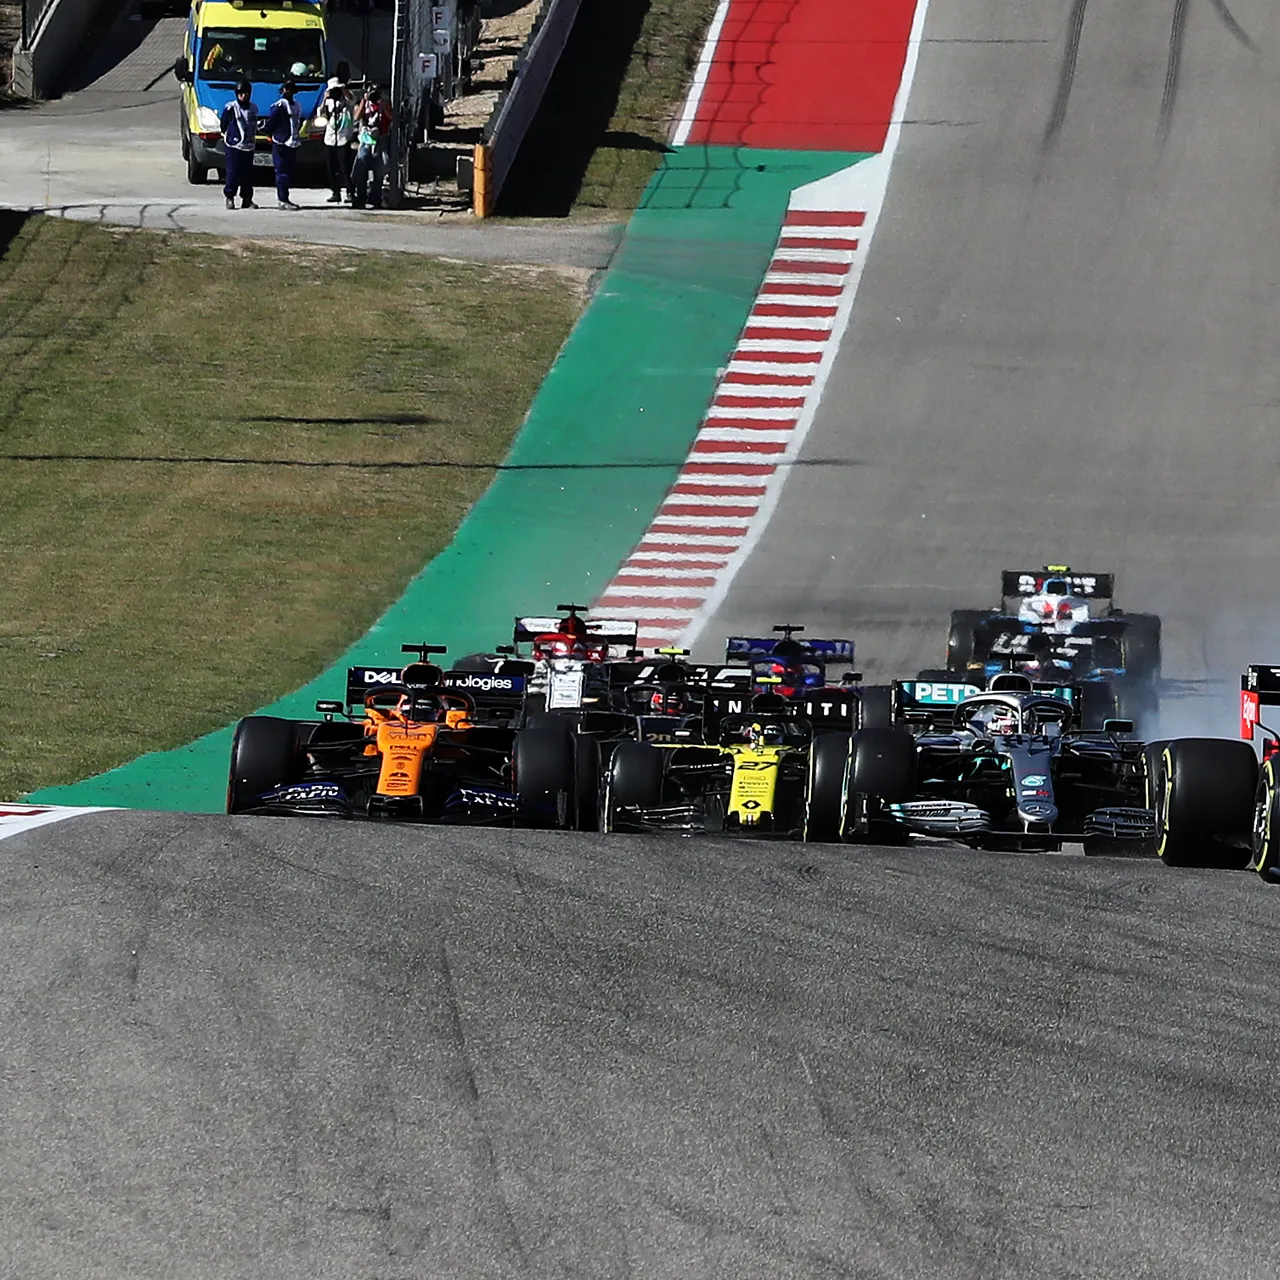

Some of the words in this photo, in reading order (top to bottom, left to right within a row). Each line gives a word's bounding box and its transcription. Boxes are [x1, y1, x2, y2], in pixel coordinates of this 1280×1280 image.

[421, 60, 430, 72] F
[364, 671, 402, 684] DEL
[737, 761, 778, 771] 27
